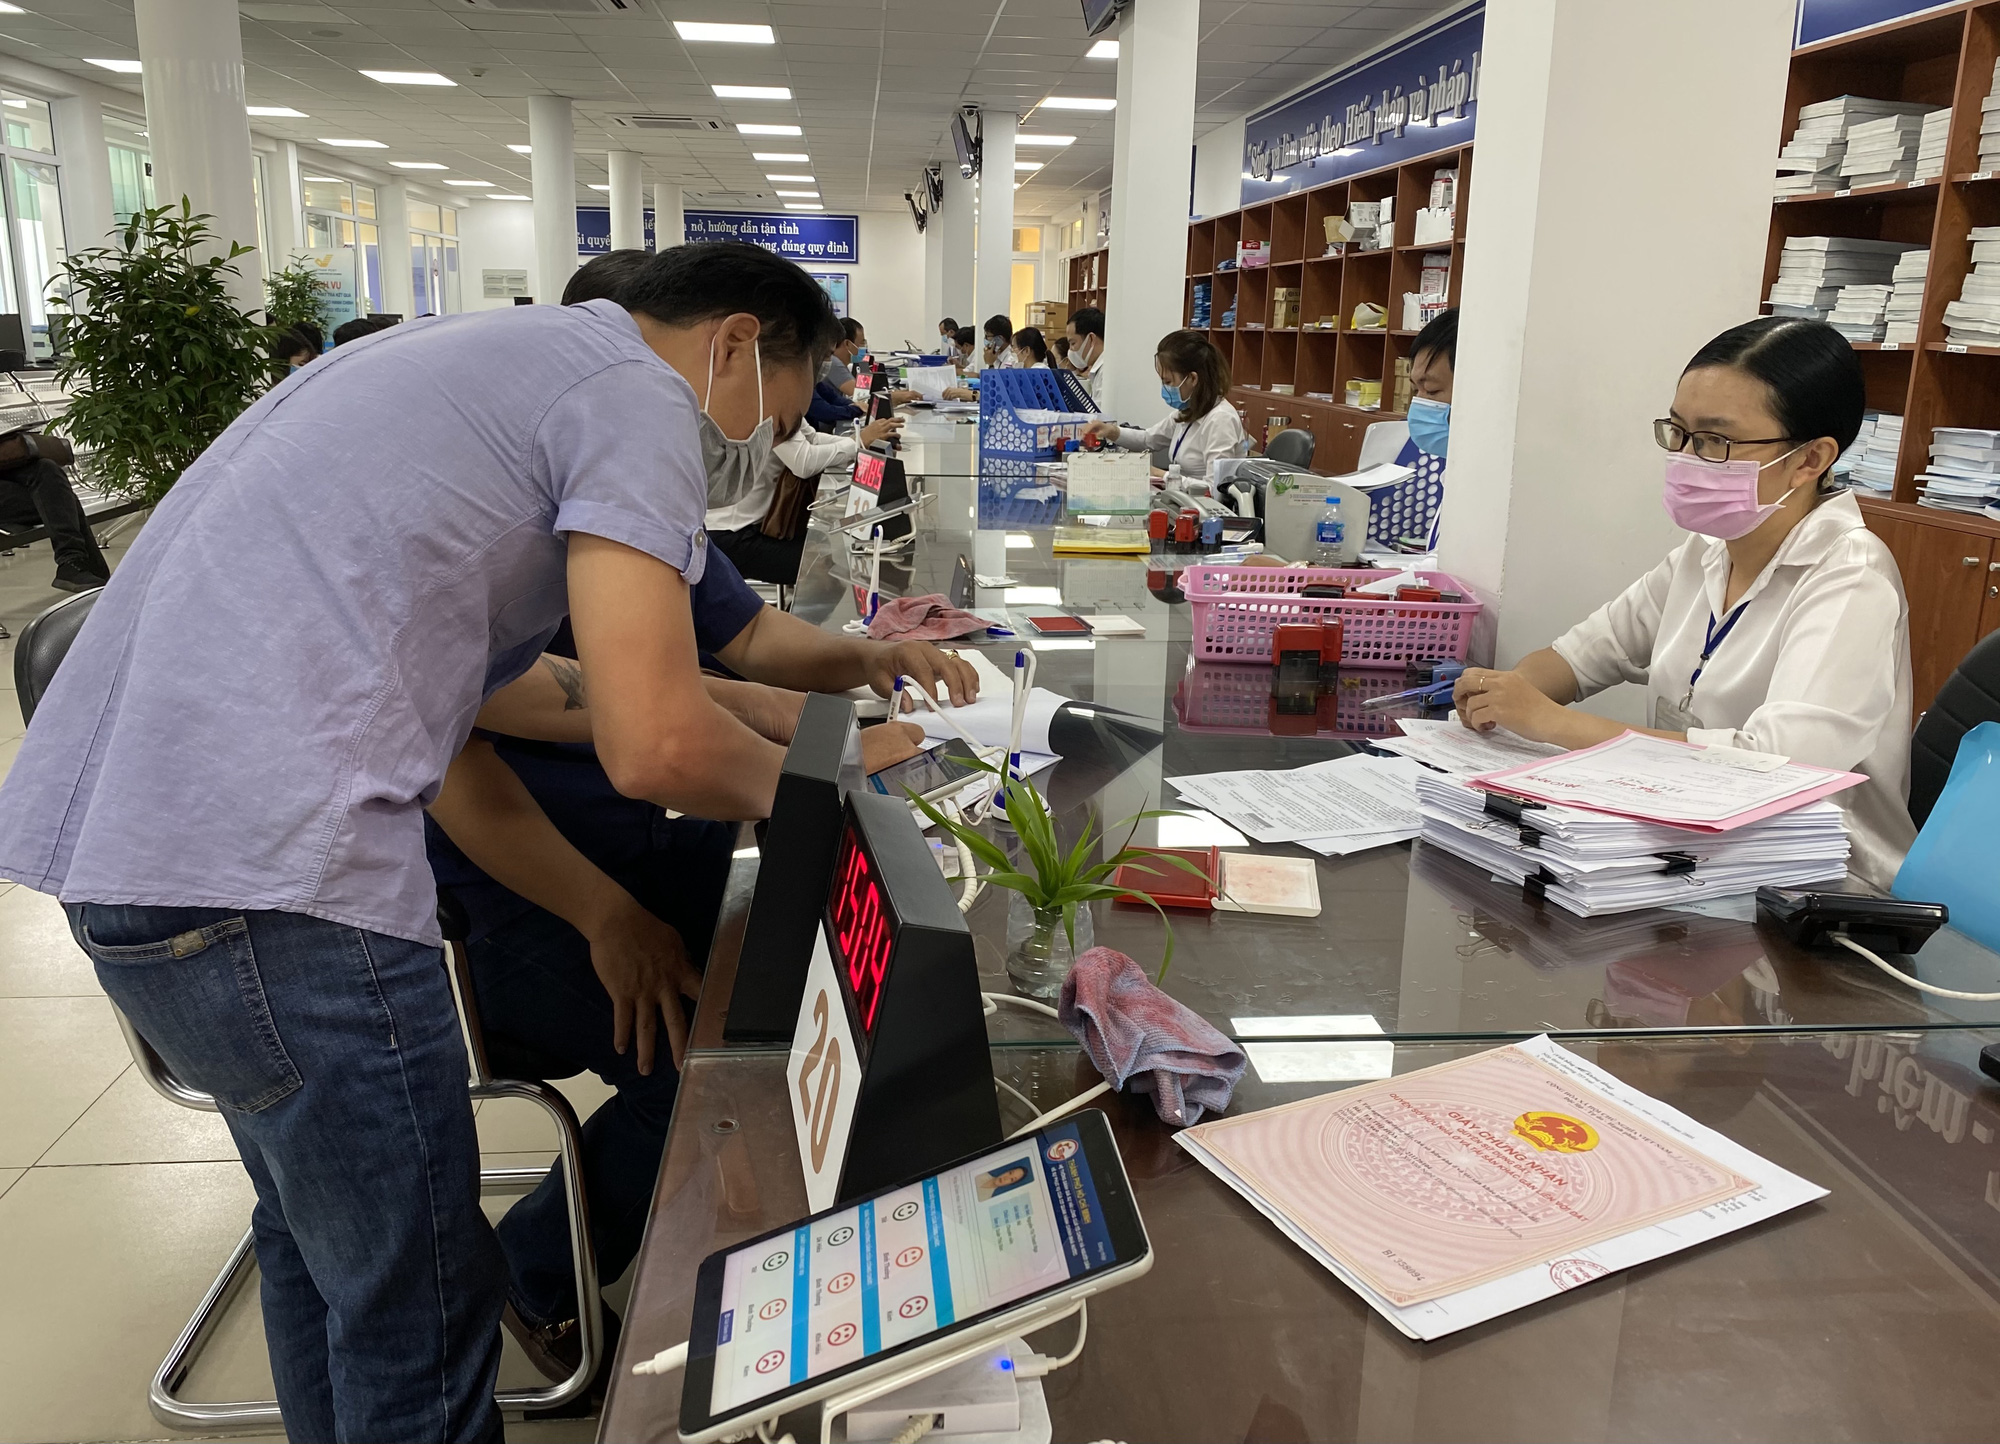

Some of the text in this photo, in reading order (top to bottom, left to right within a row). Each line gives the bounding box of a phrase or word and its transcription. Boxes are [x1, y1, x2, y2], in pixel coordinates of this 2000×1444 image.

[1320, 115, 1342, 154] theo
[1344, 94, 1372, 145] Hiến
[1372, 85, 1408, 145] pháp
[1409, 75, 1427, 121] và
[1429, 59, 1470, 127] pháp
[690, 219, 706, 237] nở,
[708, 220, 738, 236] hướng
[740, 218, 758, 234] dẫn
[760, 222, 777, 236] tận
[779, 220, 800, 235] tình
[782, 239, 805, 255] đúng
[808, 242, 824, 256] quy
[826, 240, 849, 255] định
[836, 843, 892, 1032] 1504
[799, 988, 841, 1175] 20
[1445, 1111, 1568, 1185] GIẤY CHỨNG NHẬN
[1455, 1128, 1483, 1143] QUYỀN
[1490, 1151, 1516, 1164] DỤNG
[1511, 1164, 1531, 1174] ĐẤT
[1495, 1164, 1521, 1178] KHÁC
[1067, 1158, 1079, 1178] THÀNH
[1081, 1207, 1093, 1224] MINH
